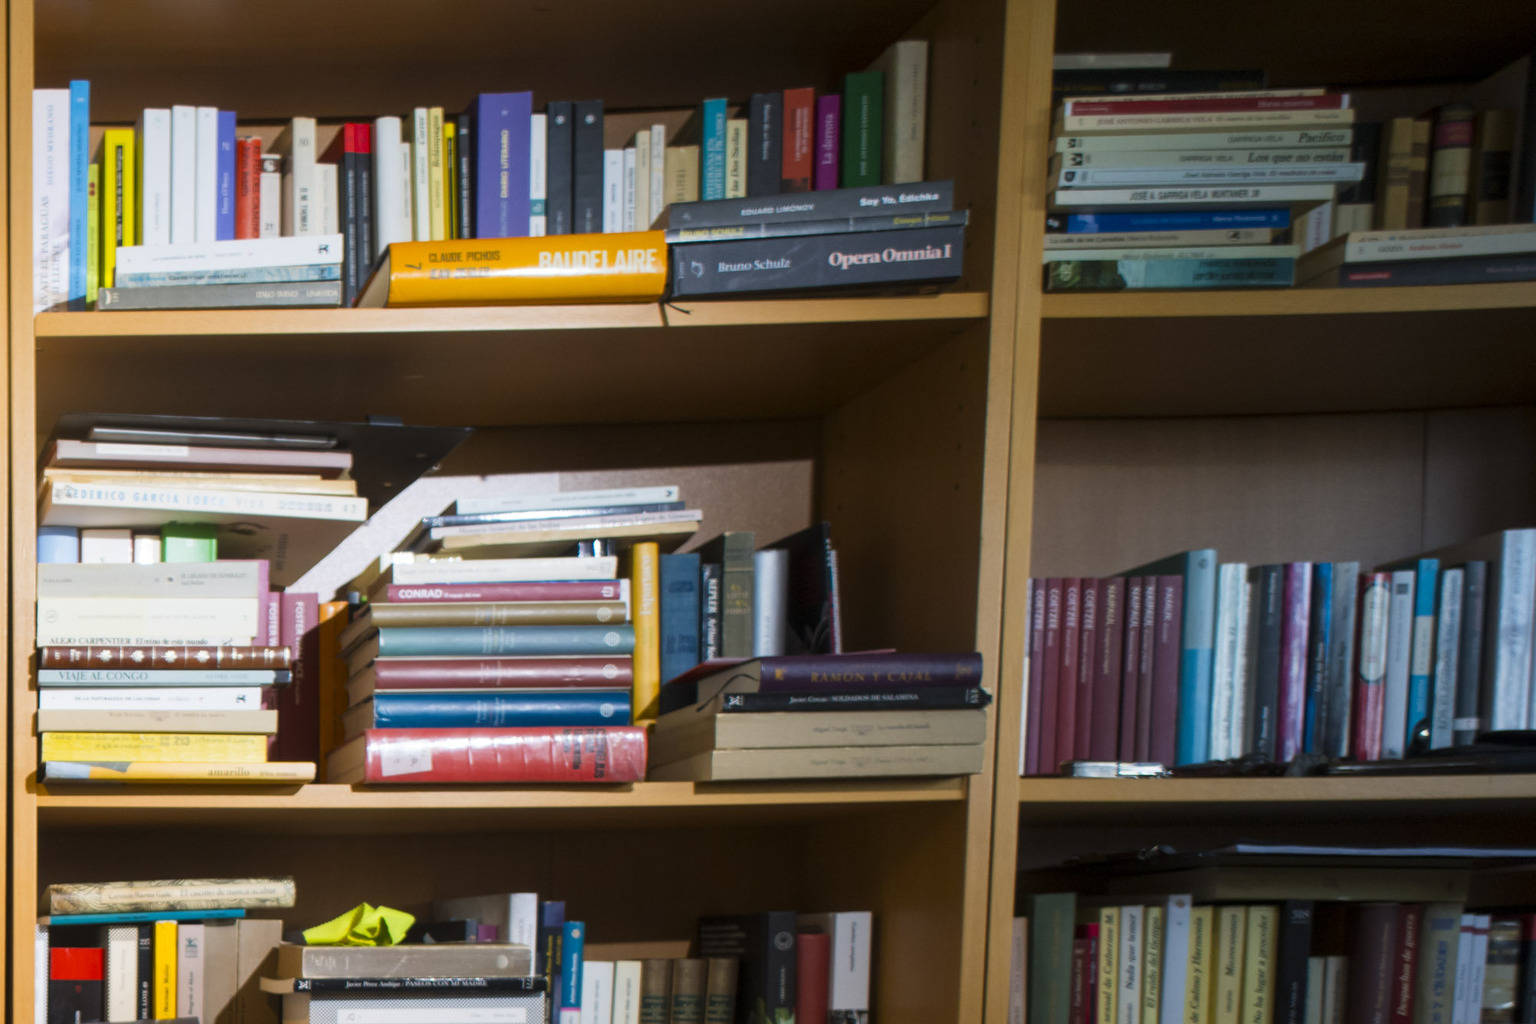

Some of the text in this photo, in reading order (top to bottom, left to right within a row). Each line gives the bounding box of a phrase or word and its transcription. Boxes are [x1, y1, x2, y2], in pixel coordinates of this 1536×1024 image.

[1298, 132, 1345, 145] Pacífico
[428, 251, 500, 262] CLAUDE PICHOIS
[538, 249, 658, 274] BAUDELAIRE
[718, 245, 952, 273] Bruno Schulz Opera Omnia I
[399, 588, 442, 598] CONRAD
[58, 671, 148, 681] VIAJE AL CONGO
